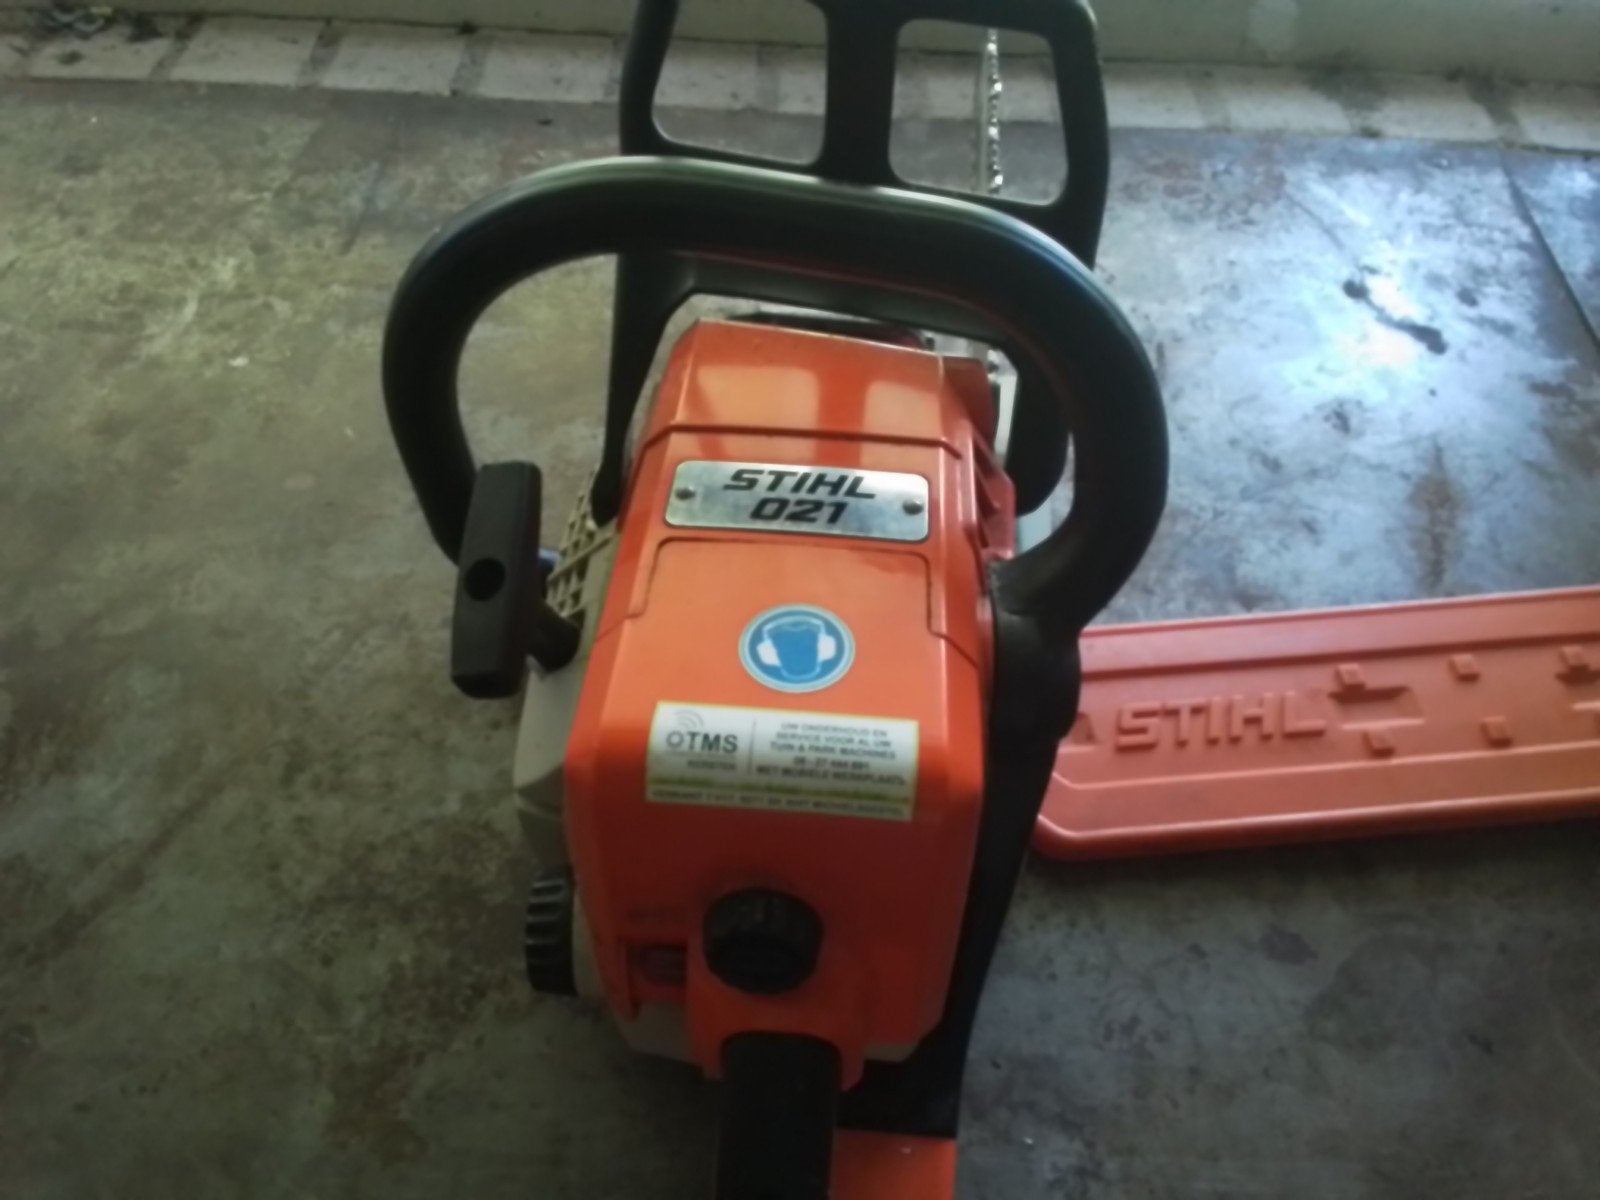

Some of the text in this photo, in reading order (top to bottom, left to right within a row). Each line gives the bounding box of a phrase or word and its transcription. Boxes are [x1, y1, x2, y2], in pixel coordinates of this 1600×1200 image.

[723, 469, 876, 499] STIHL
[749, 497, 850, 524] 021
[1114, 691, 1327, 754] STIHL
[839, 746, 896, 761] MACHINES
